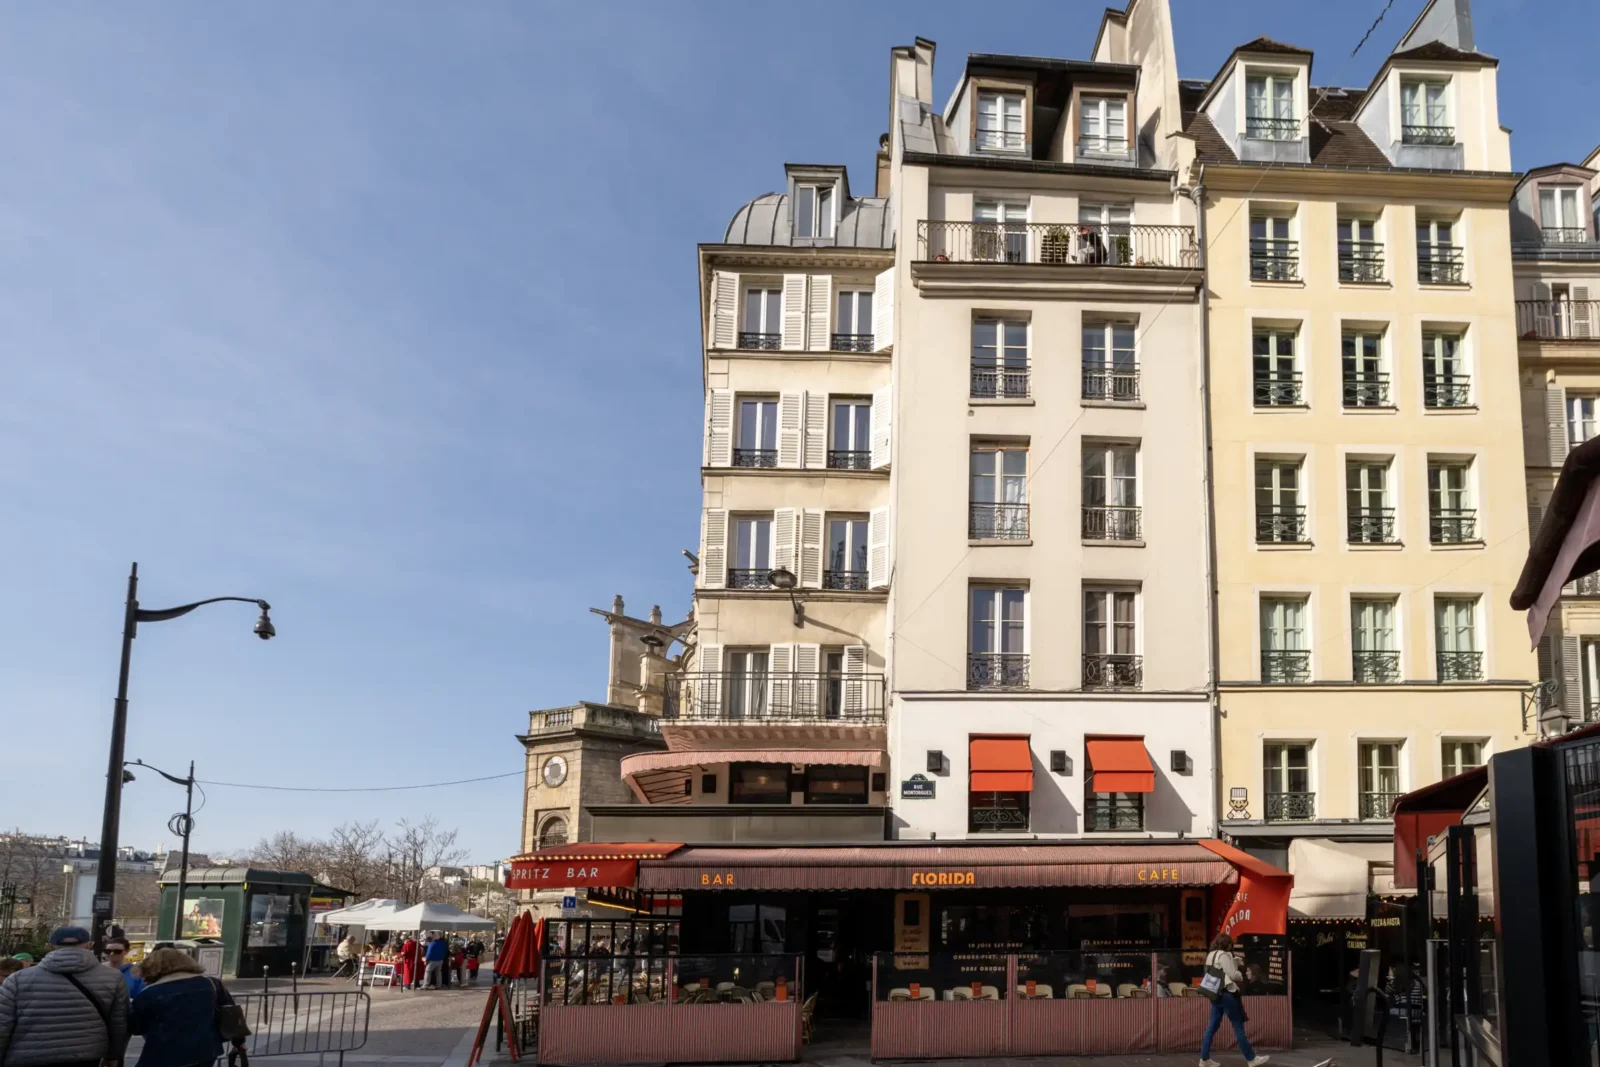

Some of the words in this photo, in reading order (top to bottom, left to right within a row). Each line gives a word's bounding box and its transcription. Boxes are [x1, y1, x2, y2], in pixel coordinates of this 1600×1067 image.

[512, 868, 551, 880] SPRITZ
[566, 867, 599, 878] BAR
[701, 873, 735, 885] BAR
[911, 872, 975, 885] FLORIDA
[1137, 869, 1179, 881] CAFE
[1225, 909, 1251, 935] ORIDA
